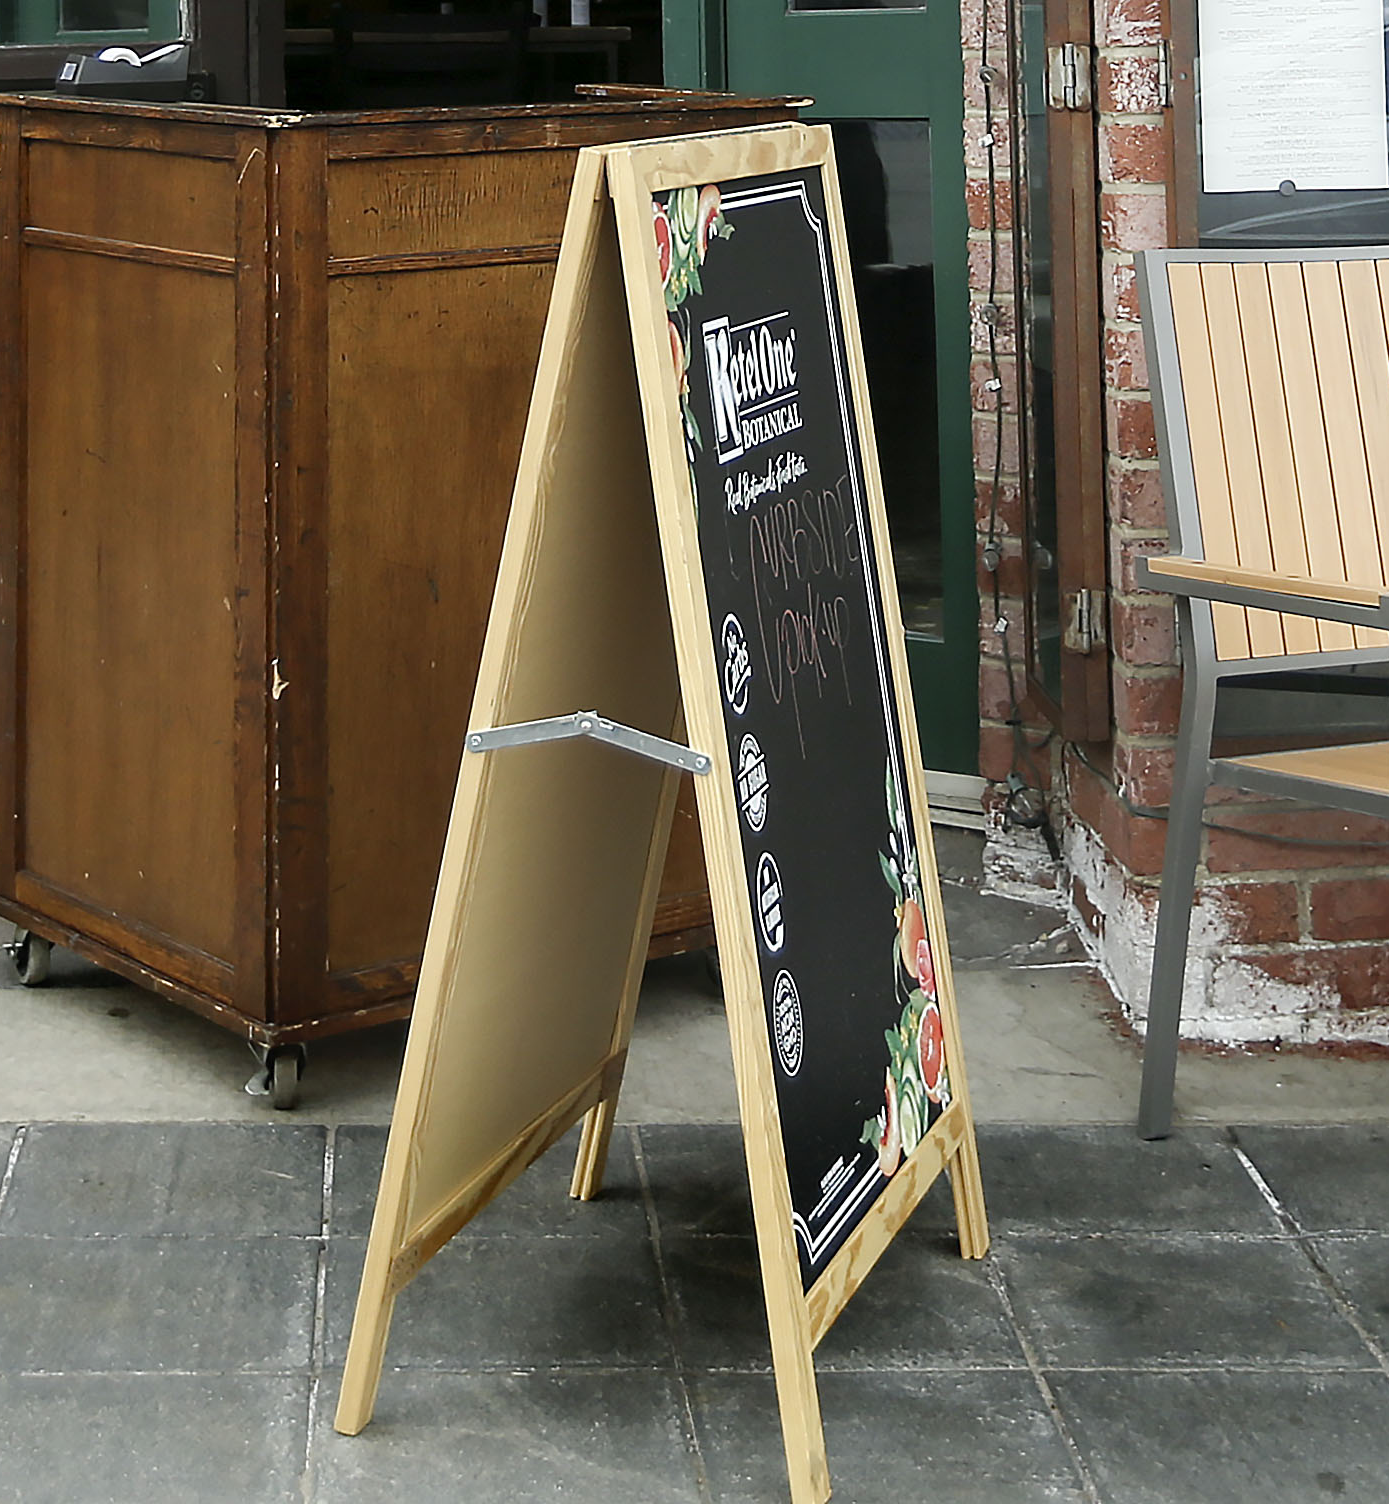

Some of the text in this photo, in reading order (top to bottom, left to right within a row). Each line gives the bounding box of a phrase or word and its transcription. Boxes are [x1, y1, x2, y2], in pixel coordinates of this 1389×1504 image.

[704, 325, 797, 446] Ketel One
[741, 402, 803, 450] BOTANICAL
